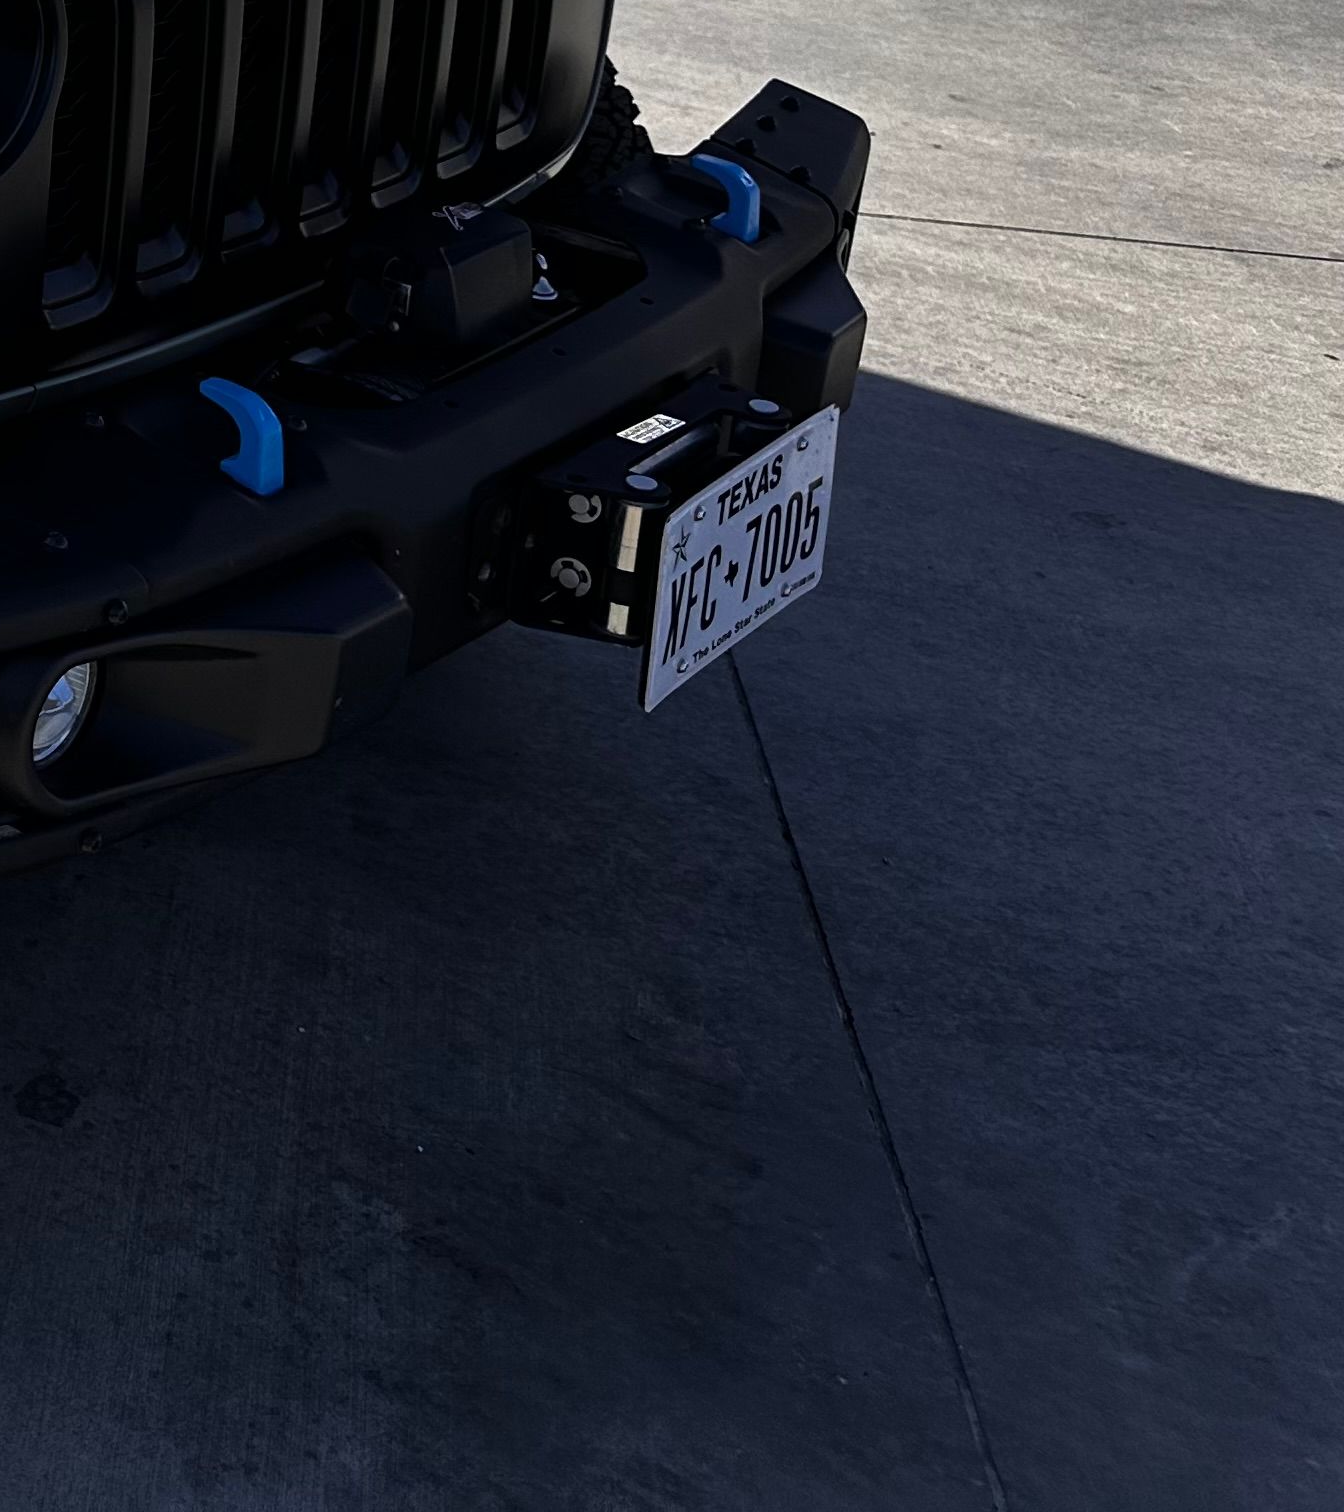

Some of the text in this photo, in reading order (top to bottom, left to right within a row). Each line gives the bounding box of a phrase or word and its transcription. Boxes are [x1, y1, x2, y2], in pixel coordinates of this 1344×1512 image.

[717, 453, 784, 526] TEXAS
[662, 476, 824, 666] XFC 7005
[692, 597, 776, 664] The Lone Star State
